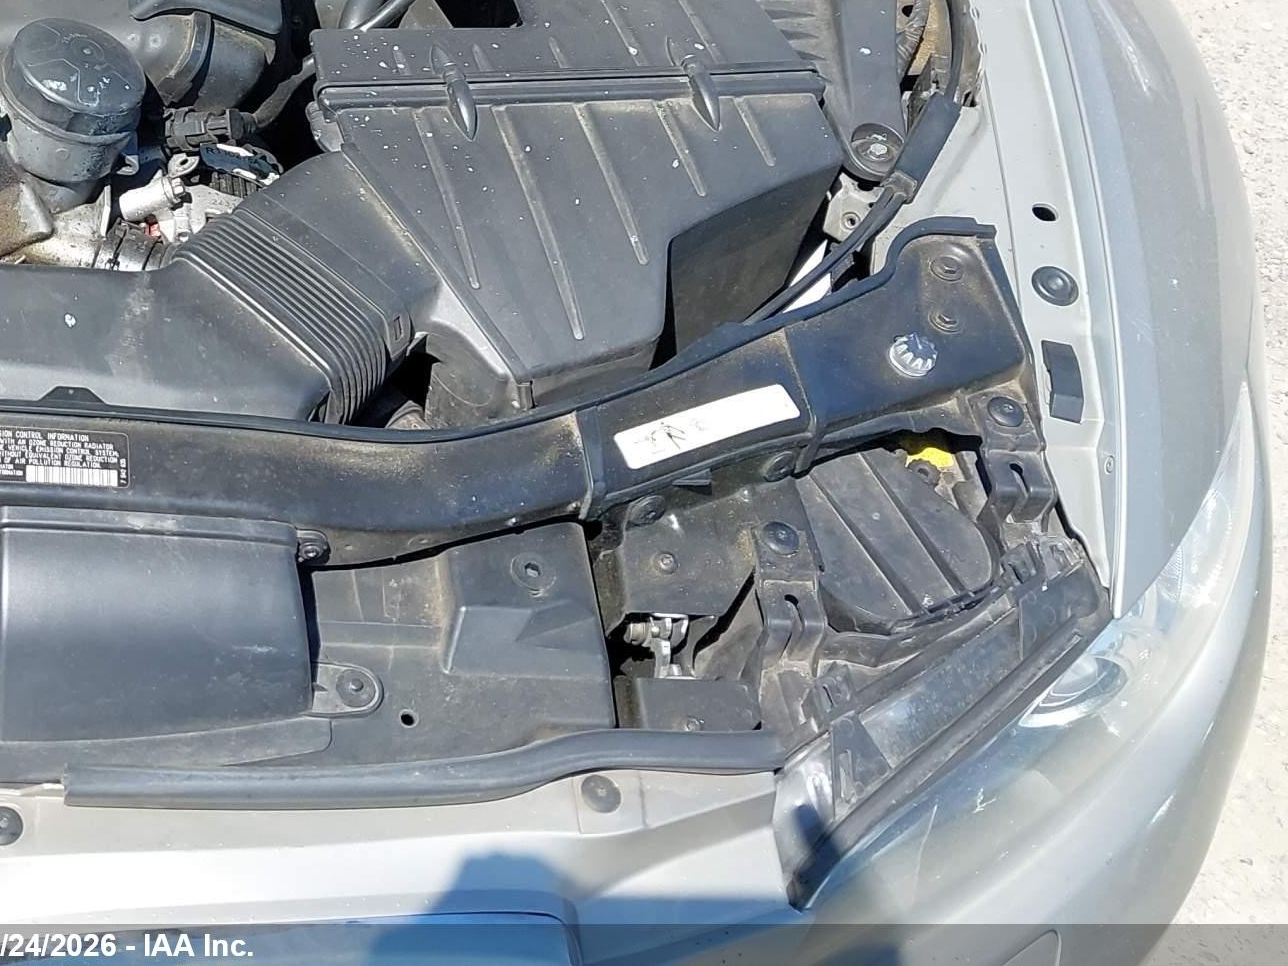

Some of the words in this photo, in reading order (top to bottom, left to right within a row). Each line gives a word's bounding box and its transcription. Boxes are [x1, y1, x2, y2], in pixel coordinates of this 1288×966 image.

[16, 431, 43, 439] CONTROL
[48, 433, 89, 441] INFORMATION
[86, 455, 117, 463] REDUCTION
